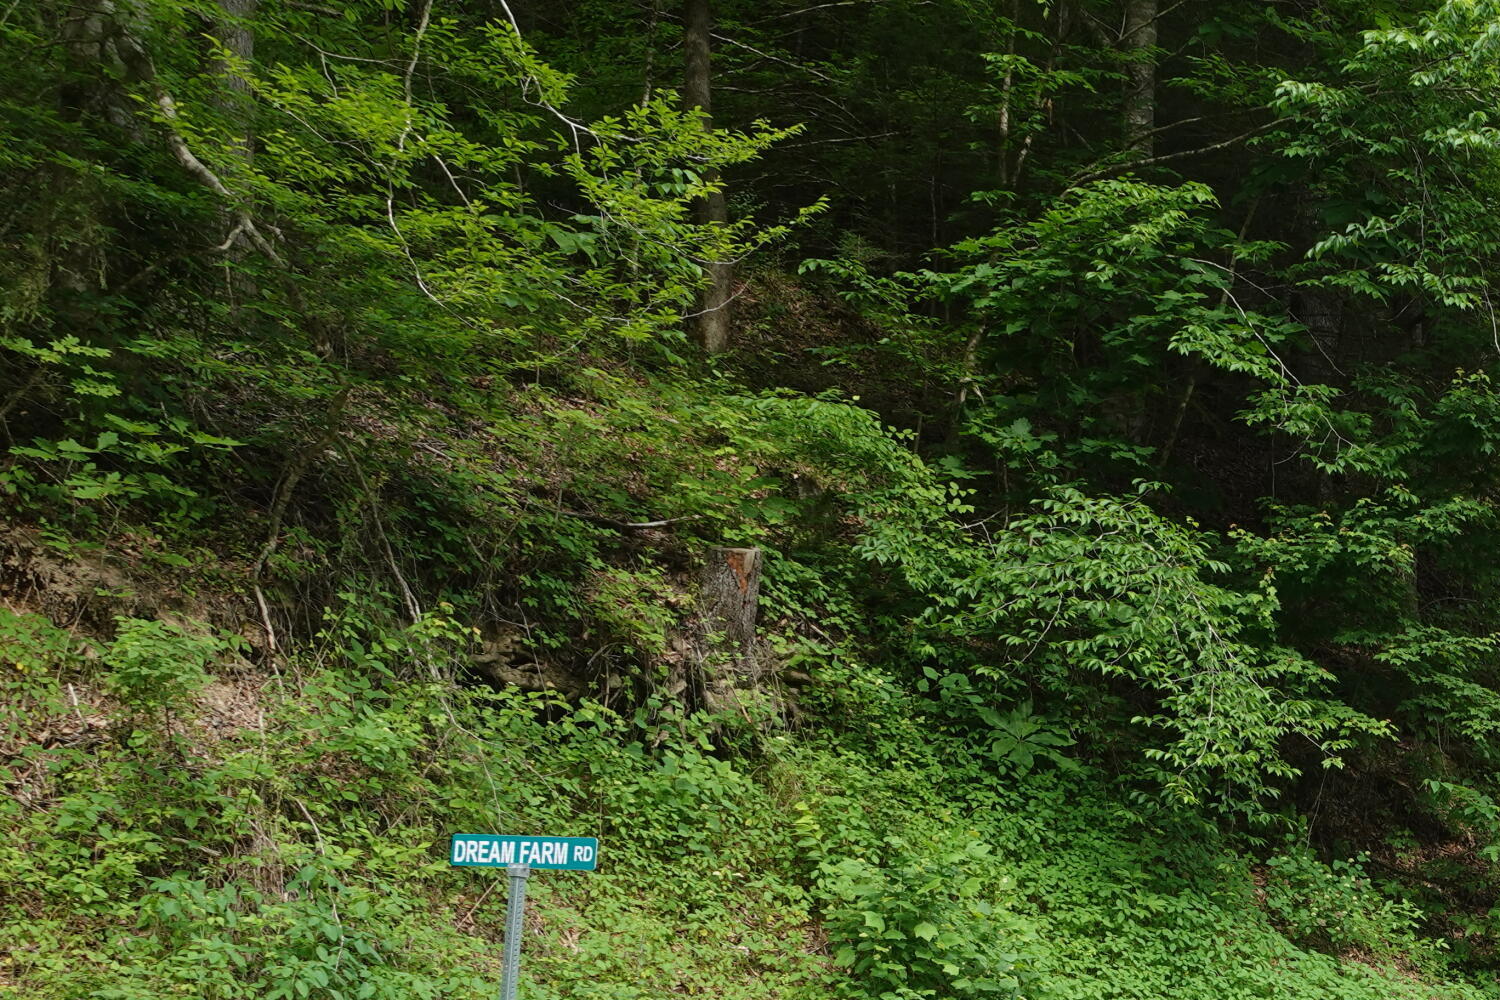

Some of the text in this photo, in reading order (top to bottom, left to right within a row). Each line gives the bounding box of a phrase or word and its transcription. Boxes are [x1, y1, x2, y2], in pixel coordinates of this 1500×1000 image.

[453, 840, 594, 865] DREAM FARM RD
